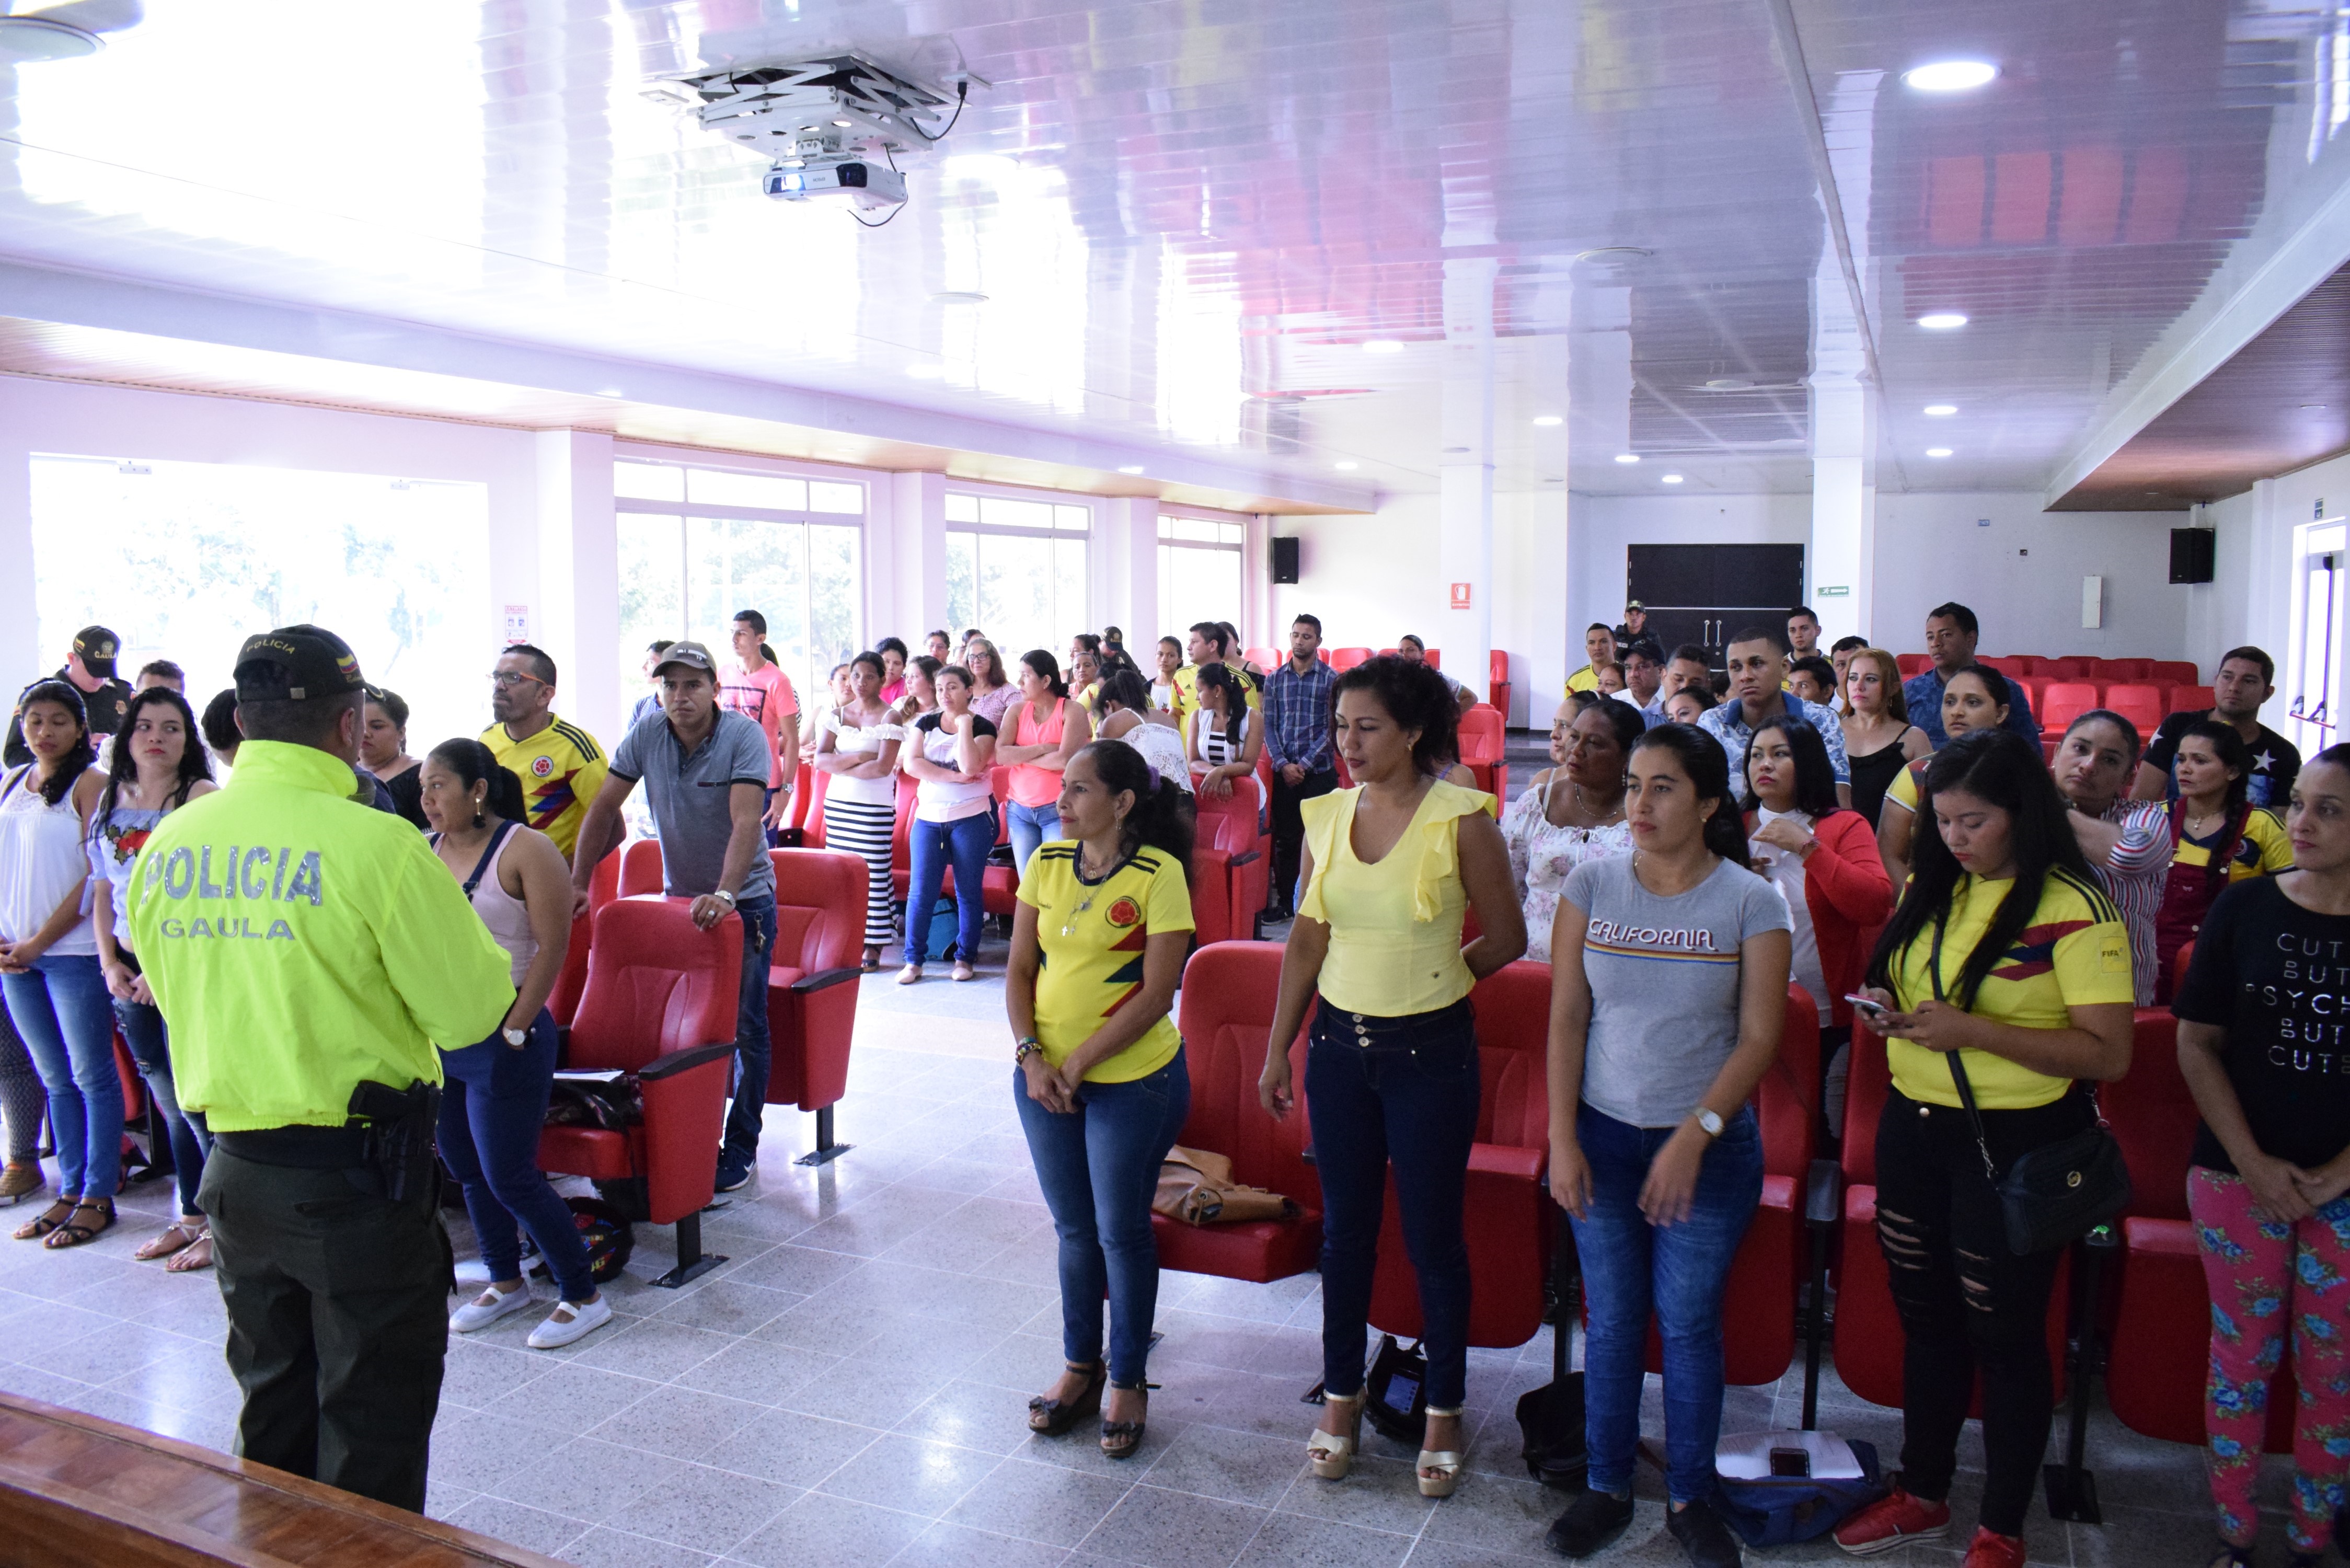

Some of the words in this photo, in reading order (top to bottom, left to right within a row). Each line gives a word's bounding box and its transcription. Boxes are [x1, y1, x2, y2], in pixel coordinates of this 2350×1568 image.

[94, 650, 117, 659] GAULA
[246, 639, 295, 654] POLICIA
[141, 845, 322, 906] POLICIA
[160, 917, 295, 940] GAULA
[1589, 918, 1719, 952] CALIFORNIA
[2281, 1018, 2345, 1045] BUT
